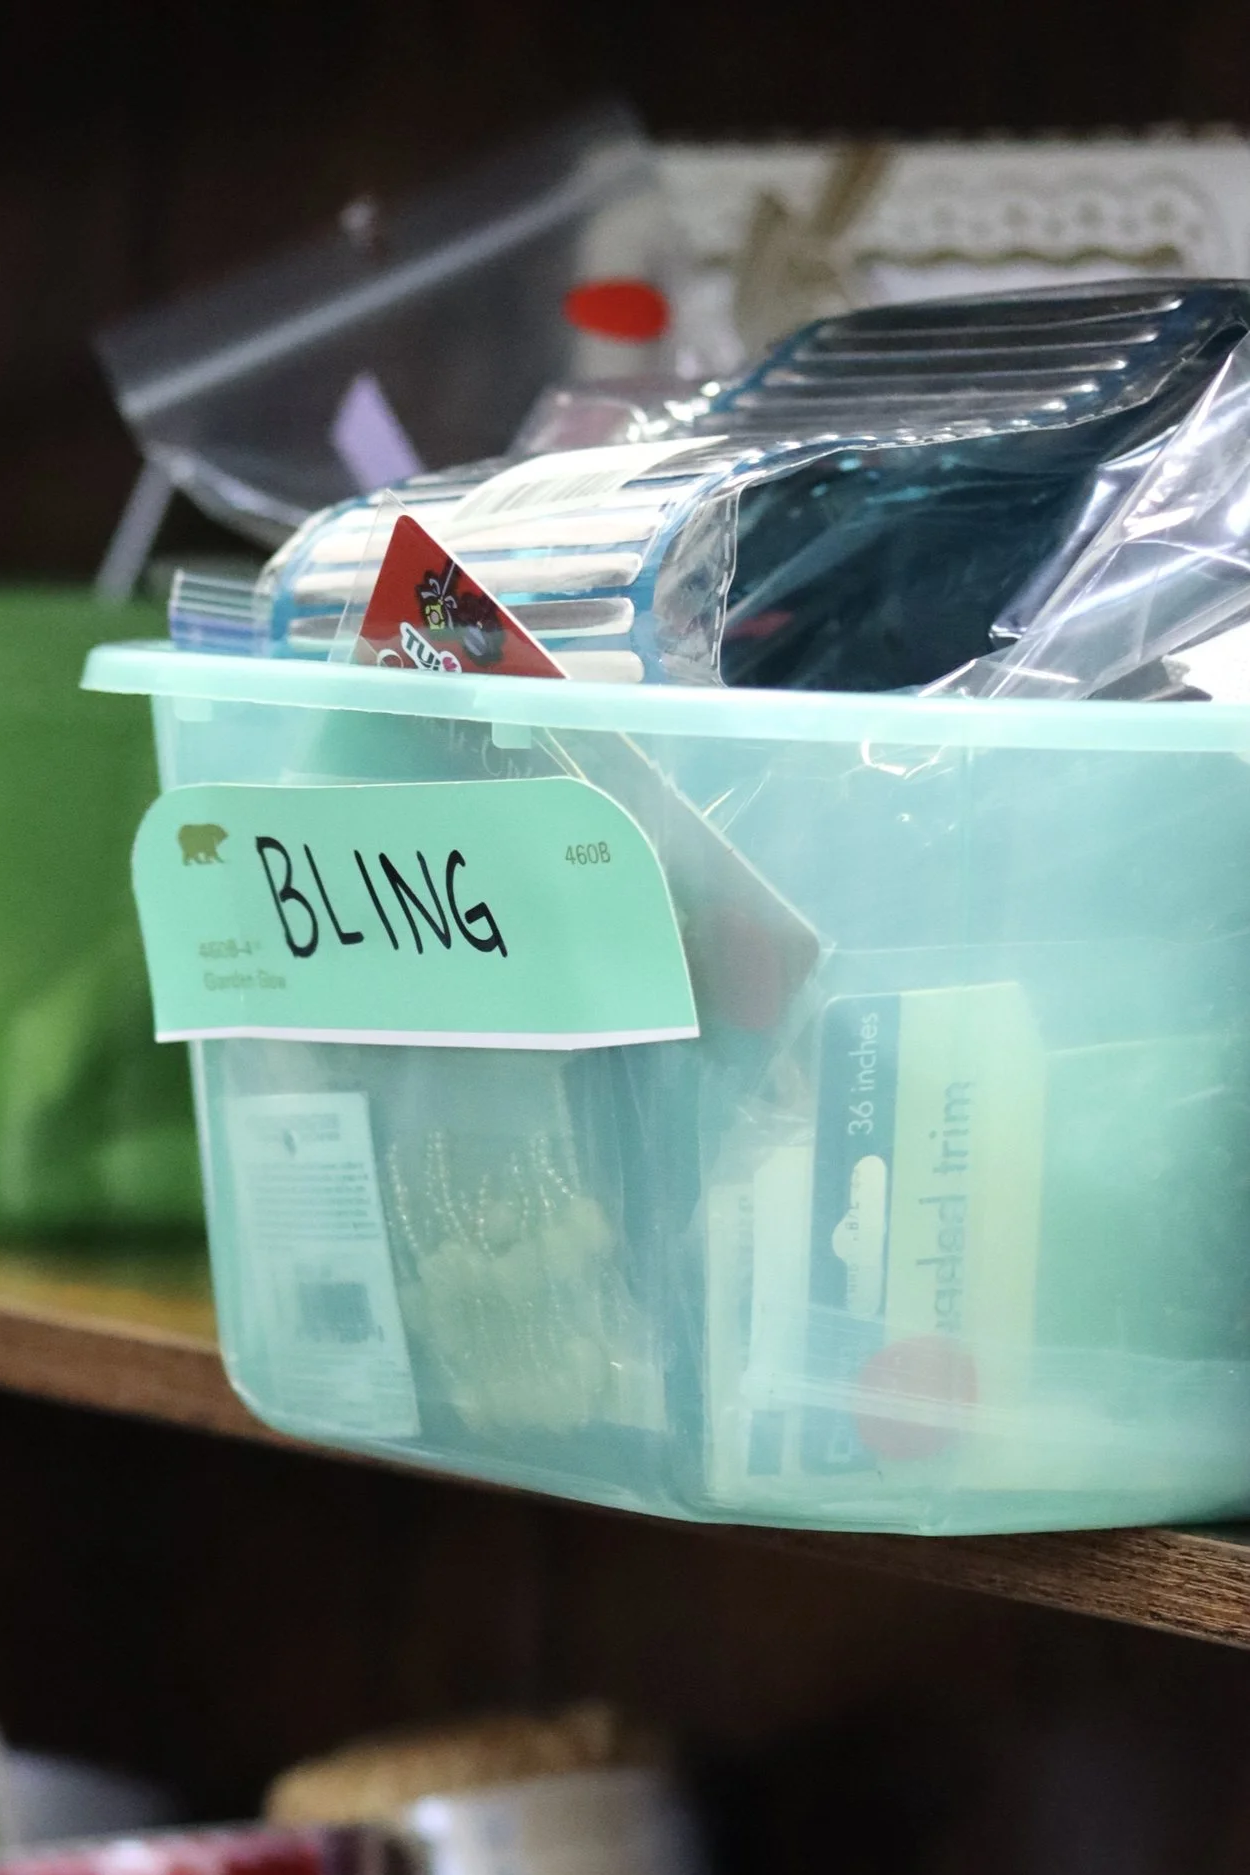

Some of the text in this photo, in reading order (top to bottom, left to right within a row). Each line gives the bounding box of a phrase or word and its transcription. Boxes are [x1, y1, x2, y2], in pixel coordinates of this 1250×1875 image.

[564, 841, 611, 864] 460B
[254, 835, 508, 959] BLING
[847, 1012, 878, 1092] inches
[847, 1100, 874, 1136] 36
[928, 1081, 975, 1176] trim
